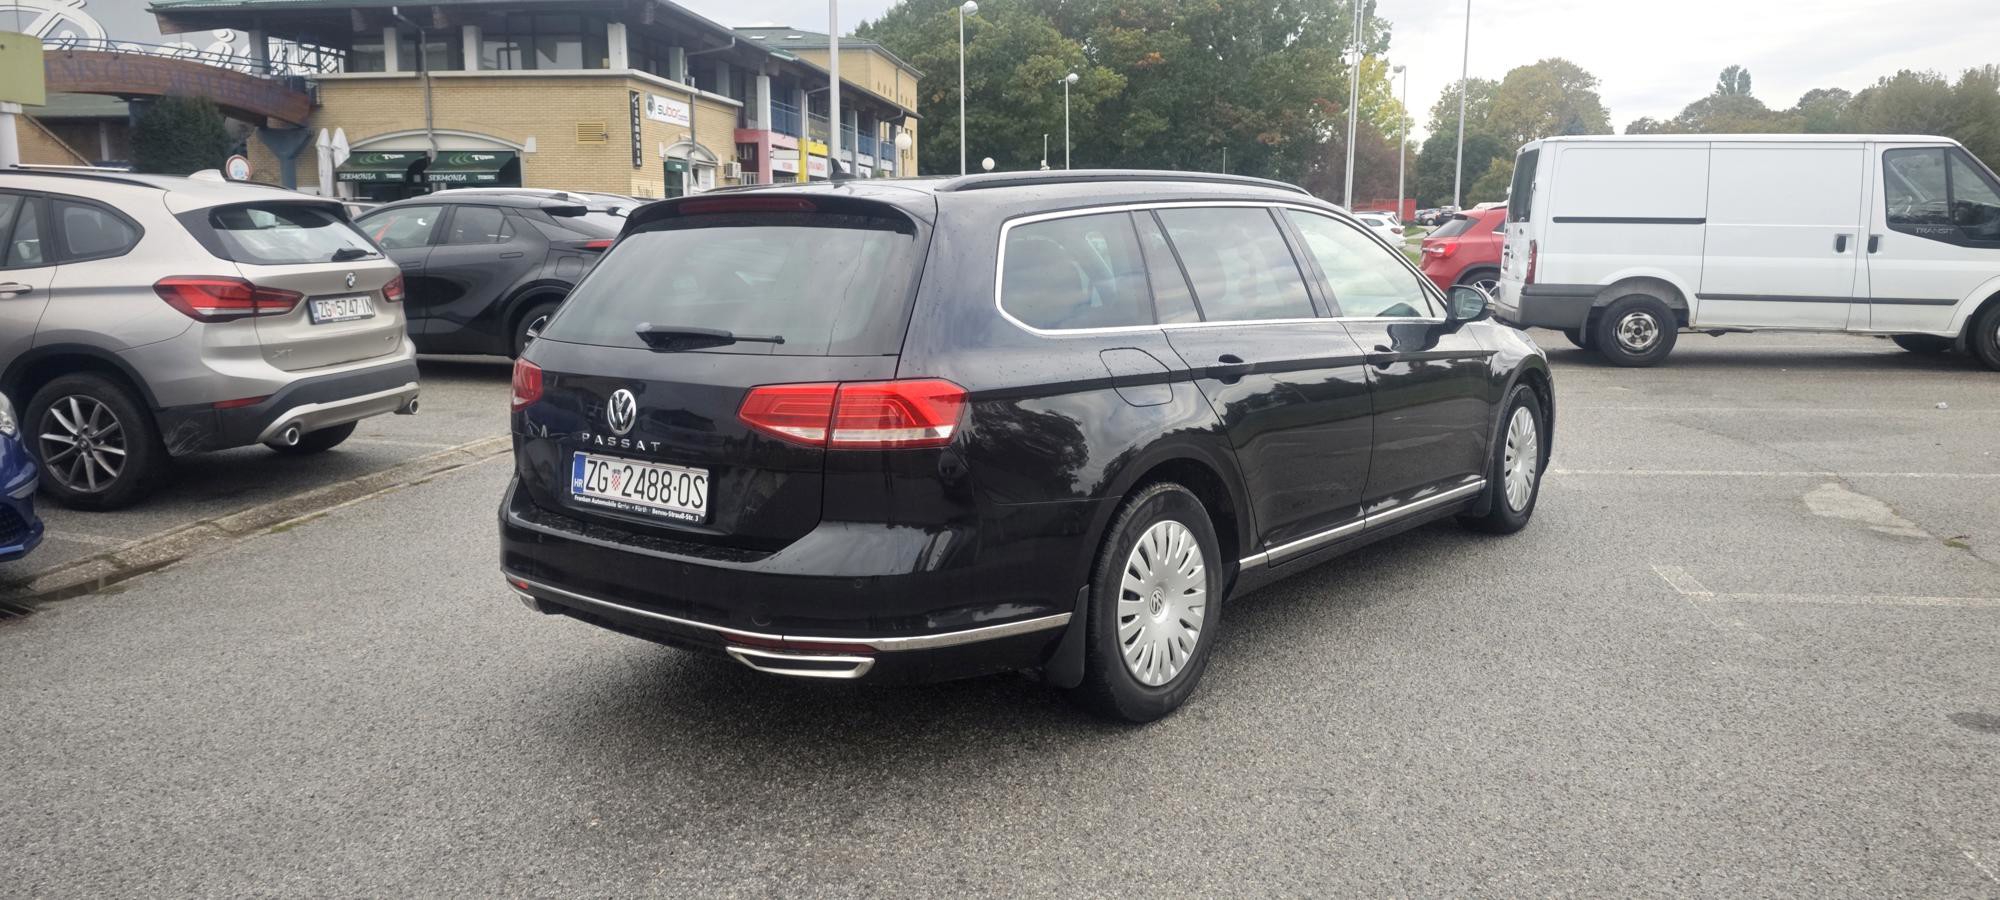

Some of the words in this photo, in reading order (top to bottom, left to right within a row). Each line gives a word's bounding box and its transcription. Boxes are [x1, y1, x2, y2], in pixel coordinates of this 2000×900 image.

[428, 173, 467, 182] SERMONIA
[318, 301, 332, 317] ZG
[581, 432, 661, 452] PASSAT
[574, 477, 584, 489] HR
[585, 459, 610, 493] ZG
